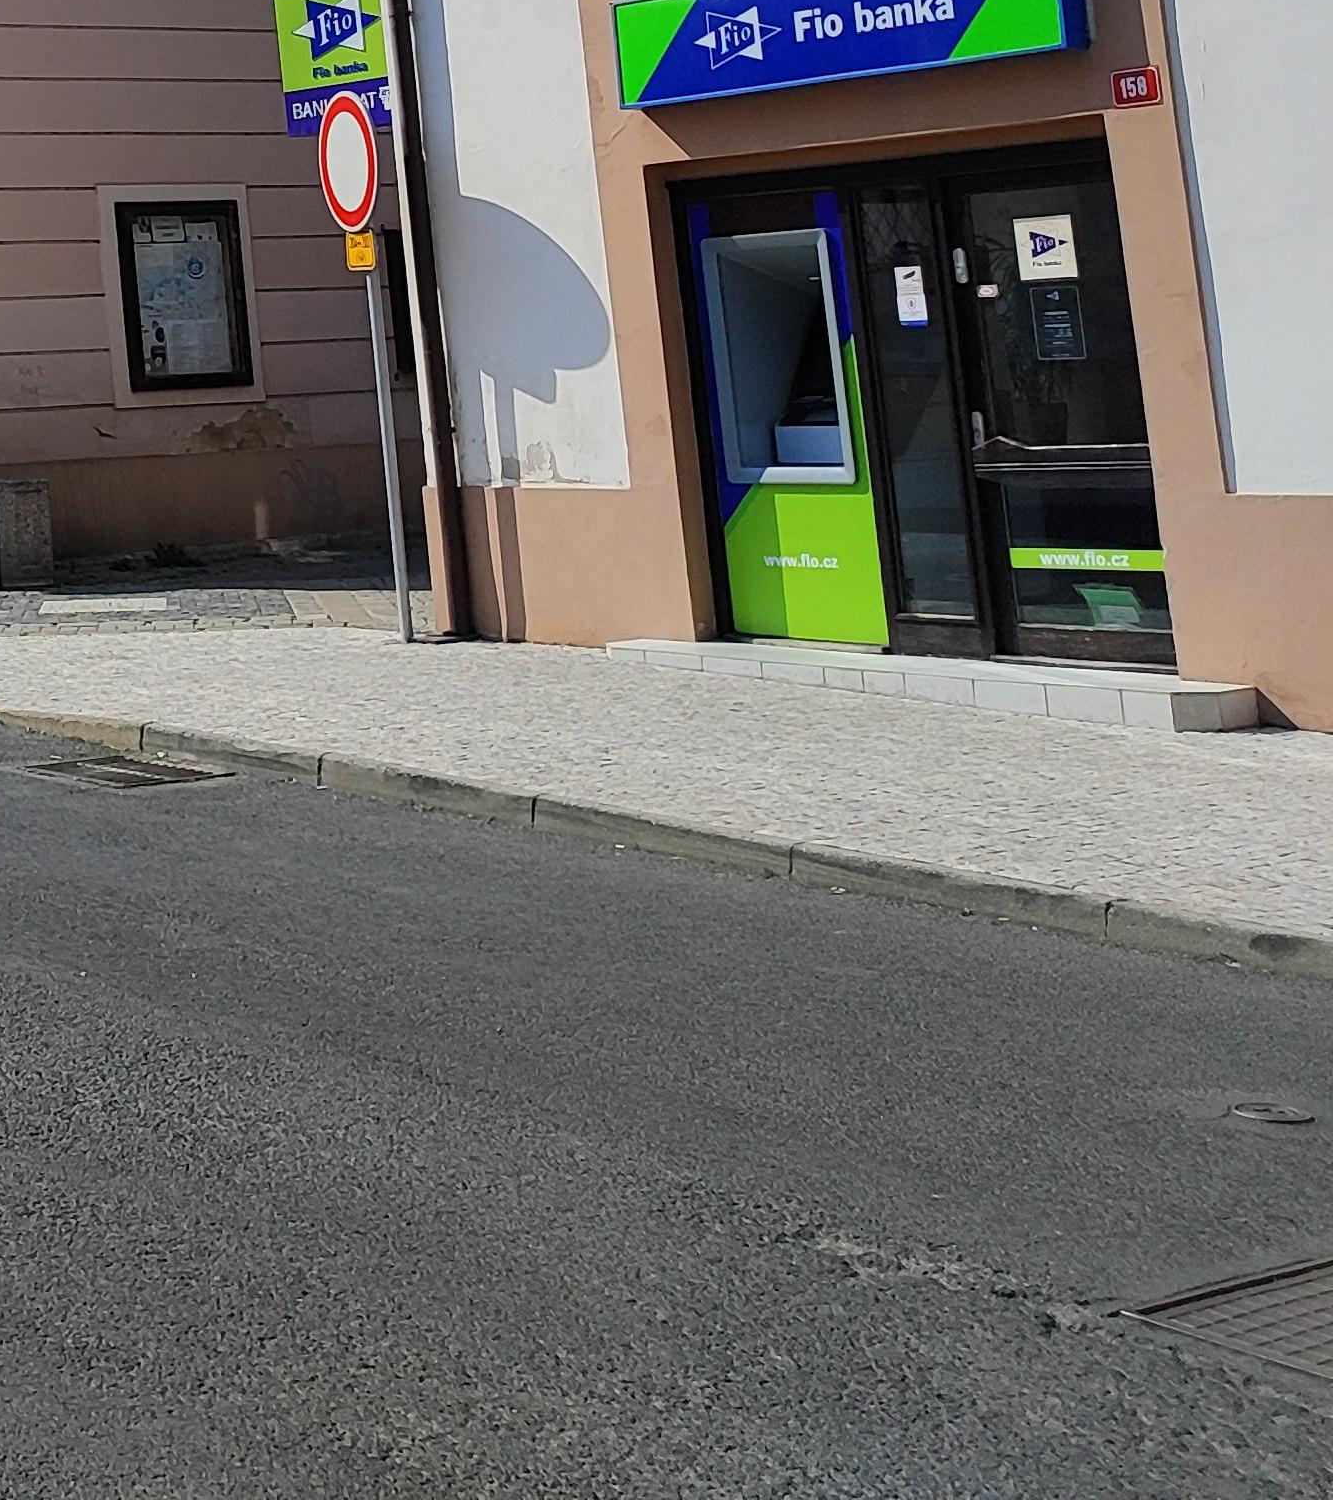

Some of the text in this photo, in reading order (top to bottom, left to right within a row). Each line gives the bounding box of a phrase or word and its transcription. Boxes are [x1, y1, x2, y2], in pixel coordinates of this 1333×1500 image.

[317, 8, 353, 47] Fio
[793, 7, 844, 43] Fio
[717, 21, 752, 55] Fio
[312, 60, 369, 81] Fio banka
[1120, 75, 1148, 99] 158
[763, 553, 840, 569] www.fio.cz
[1039, 550, 1131, 567] www.fio.cz
